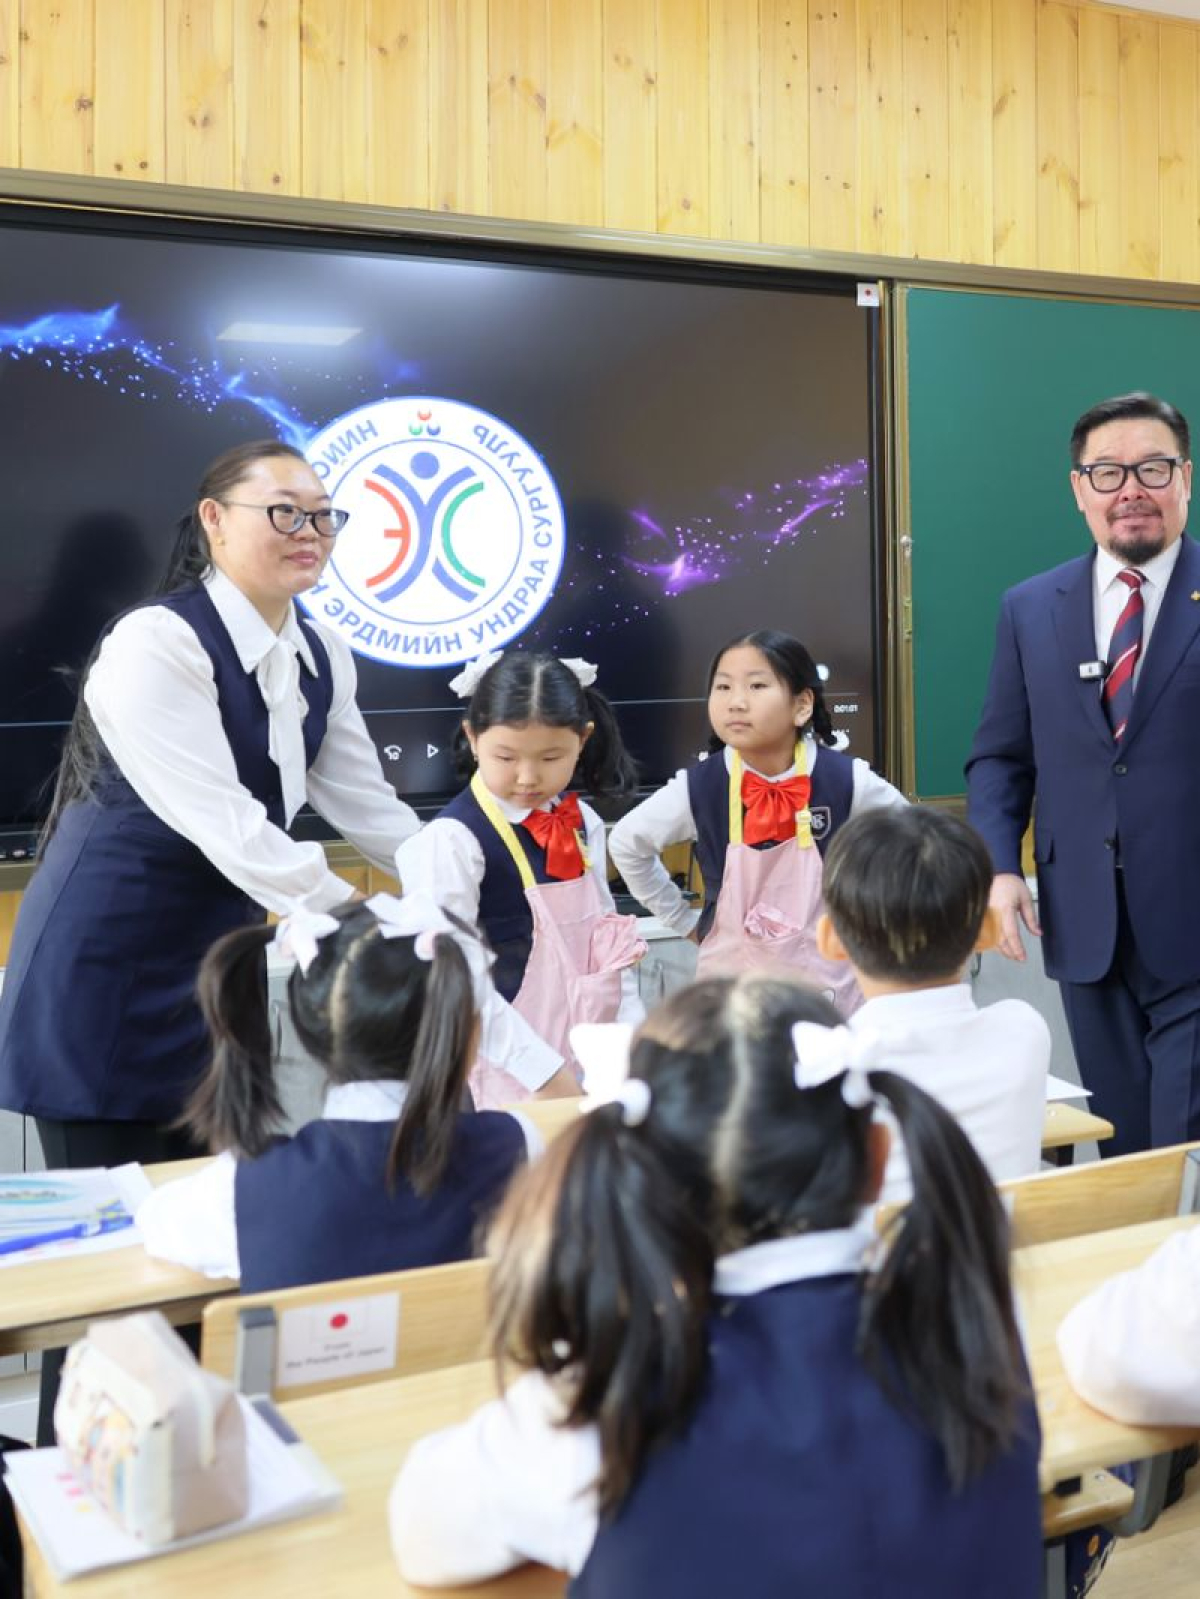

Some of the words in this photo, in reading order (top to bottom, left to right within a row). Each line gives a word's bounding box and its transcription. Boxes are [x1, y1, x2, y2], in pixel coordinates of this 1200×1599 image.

[473, 424, 552, 547] СУРГУУЛЬ
[324, 598, 462, 654] ЭРДМИЙН
[468, 559, 549, 644] УНДРАА
